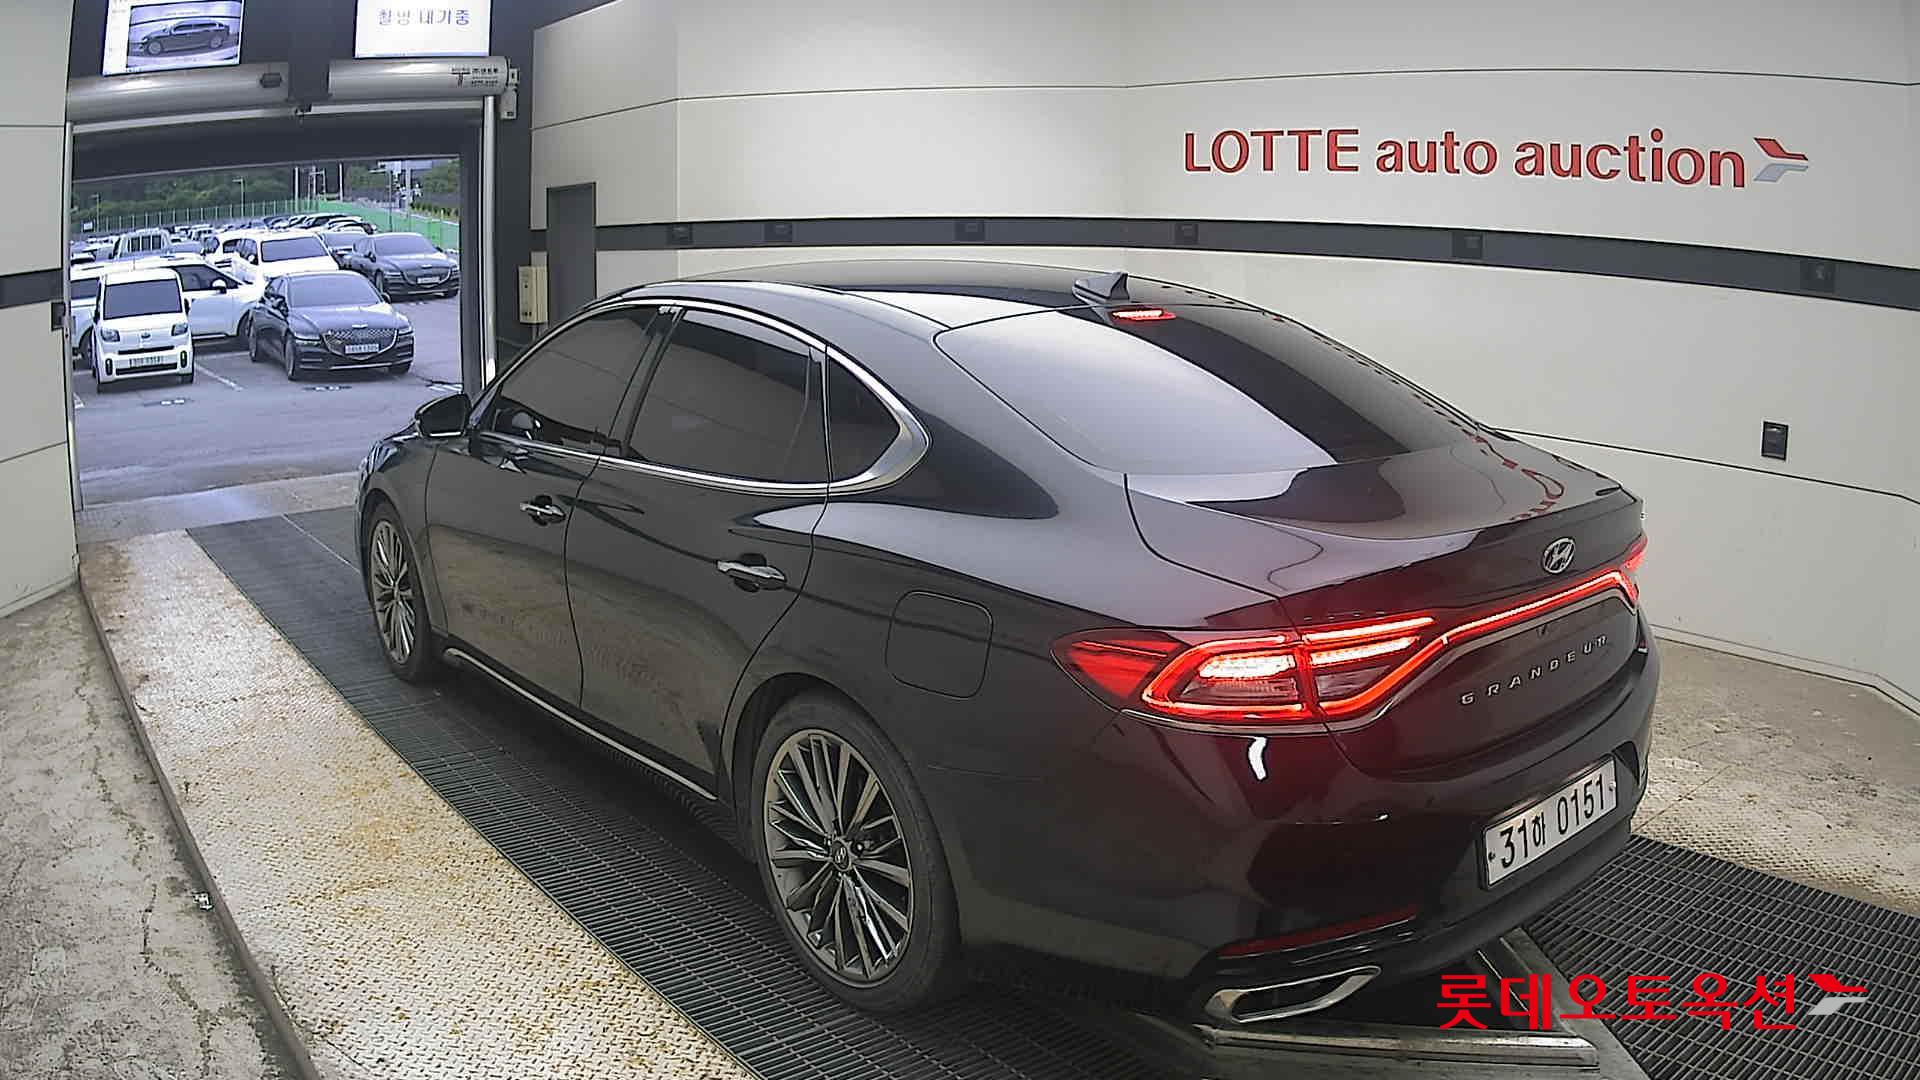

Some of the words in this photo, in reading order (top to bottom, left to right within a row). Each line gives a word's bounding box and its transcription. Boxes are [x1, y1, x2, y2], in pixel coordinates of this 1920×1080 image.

[1185, 130, 1359, 172] LOTTE
[1376, 132, 1498, 175] auto
[1515, 128, 1746, 188] auction
[1460, 636, 1608, 706] GRANDEUR
[1500, 811, 1546, 869] 31하
[1556, 774, 1606, 836] 0151
